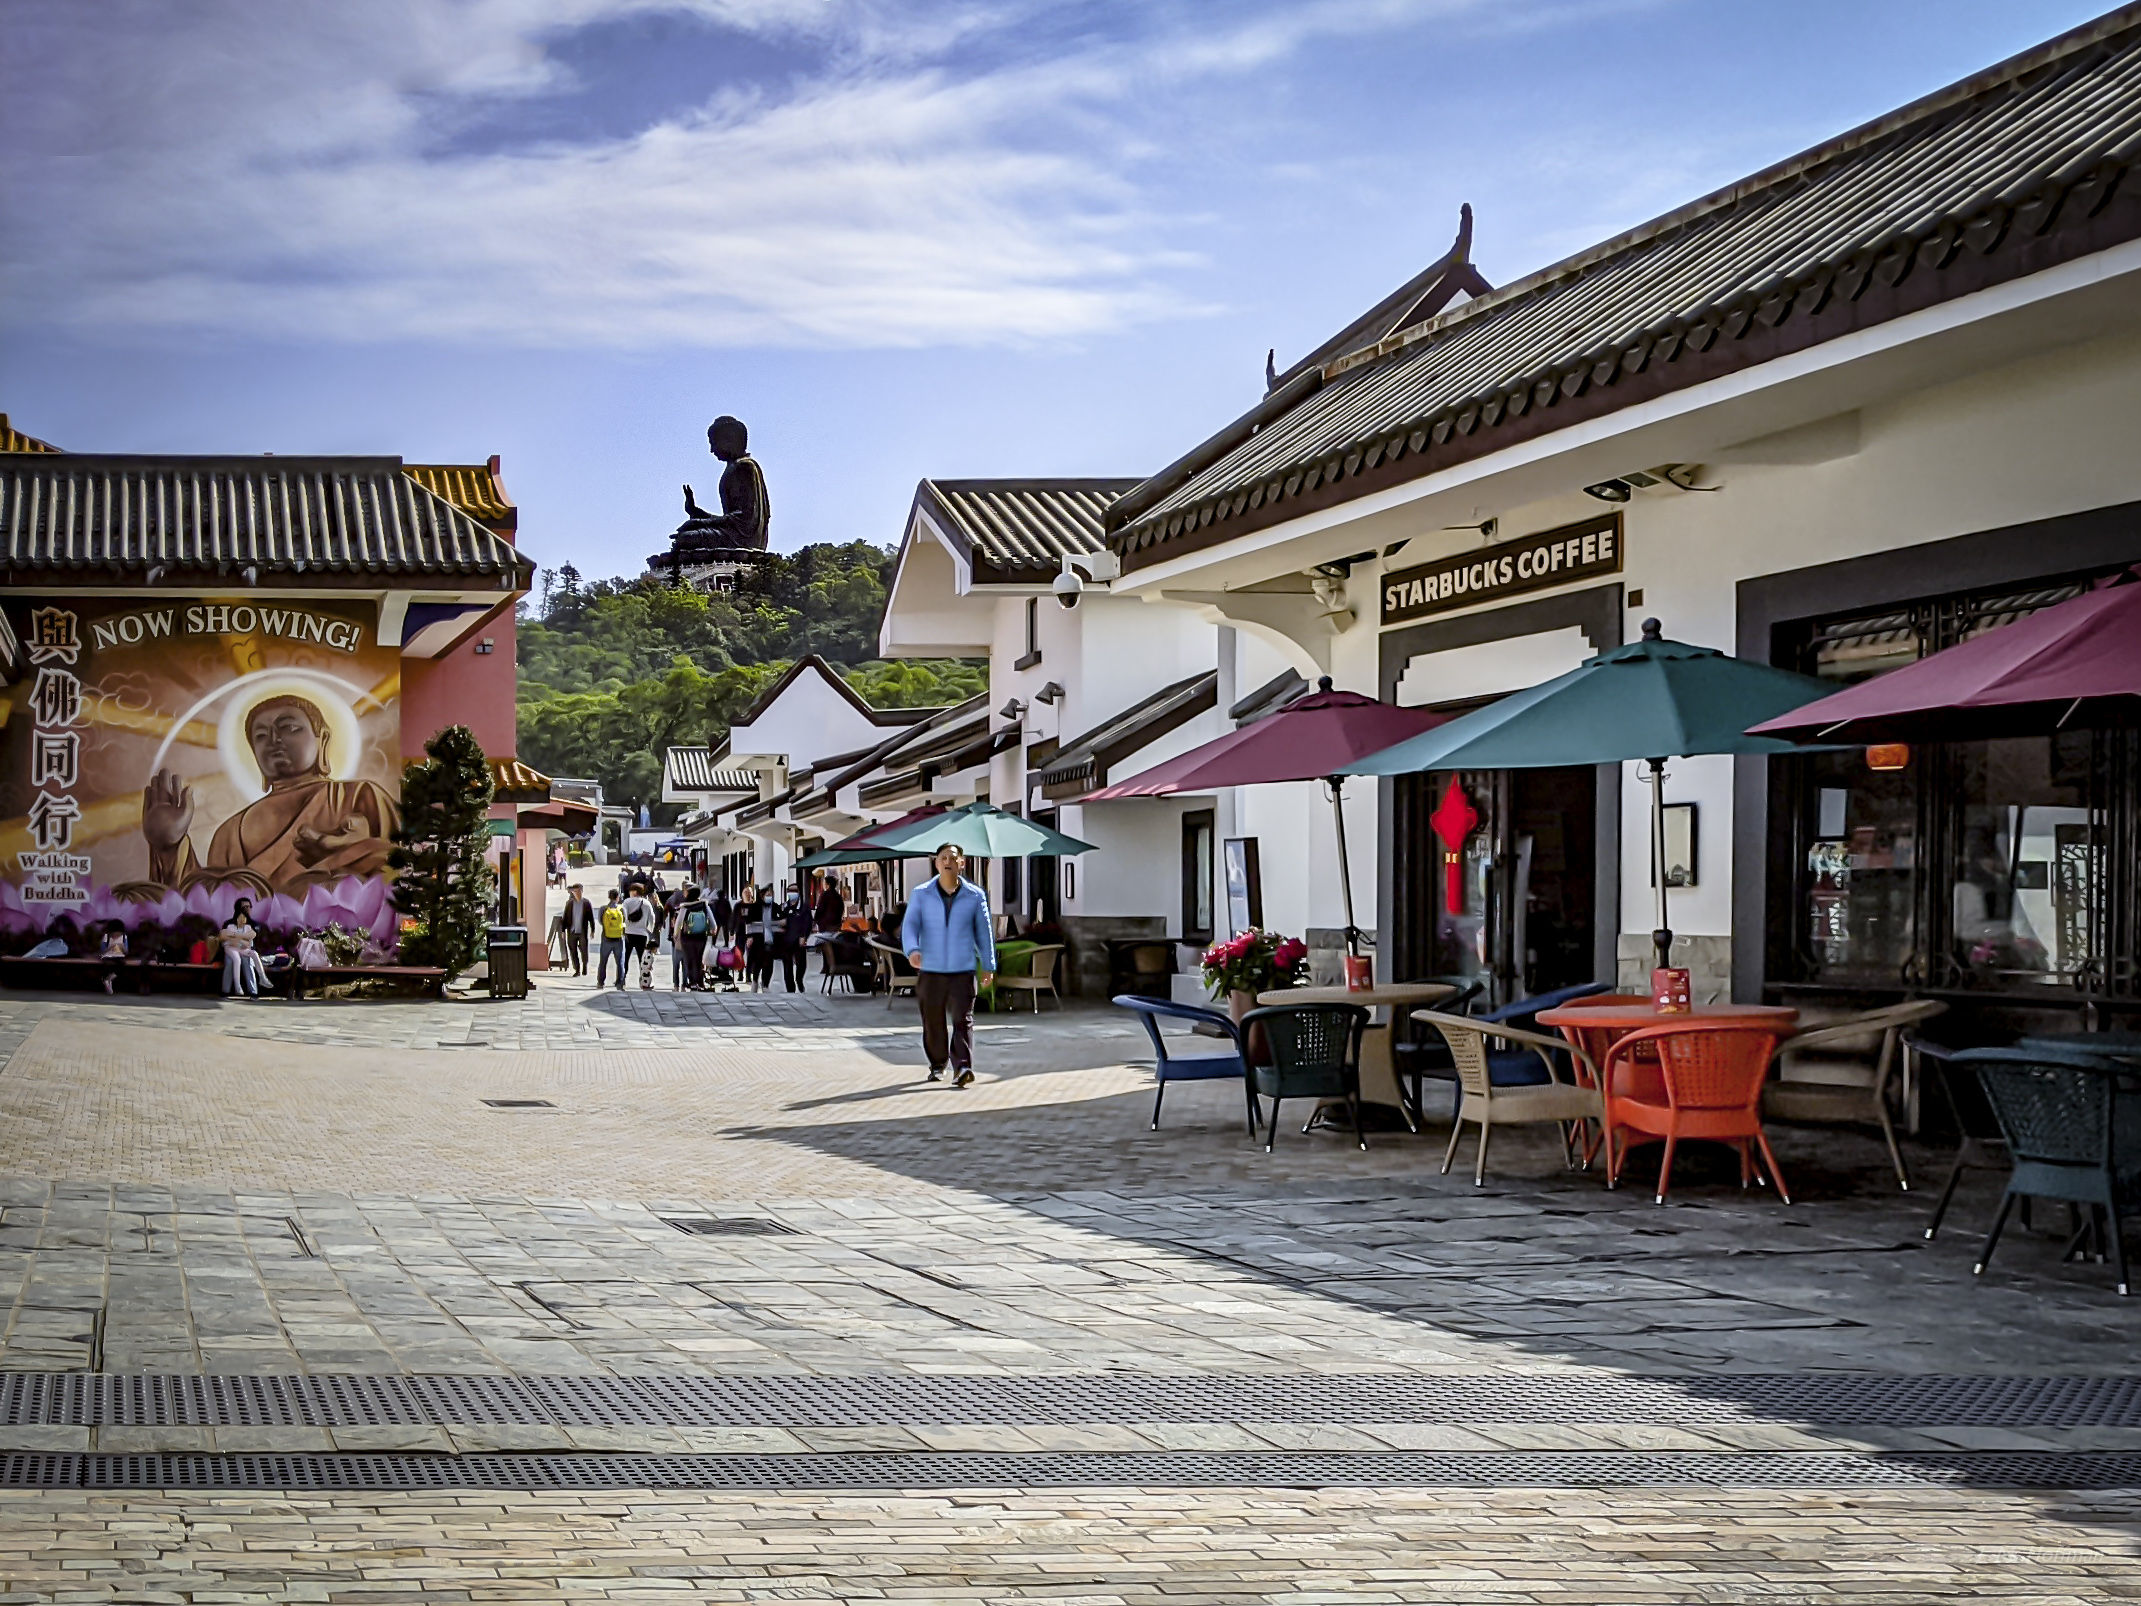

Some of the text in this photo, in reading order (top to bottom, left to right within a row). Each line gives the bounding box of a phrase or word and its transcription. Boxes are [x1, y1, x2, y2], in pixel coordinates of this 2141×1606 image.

[1385, 529, 1613, 612] STARBUCKS COFFEE
[92, 605, 361, 652] NOW SHOWING!
[28, 607, 81, 850] 與佛同行
[20, 854, 89, 871] Walking
[36, 871, 72, 884] with
[23, 886, 86, 900] Buddha
